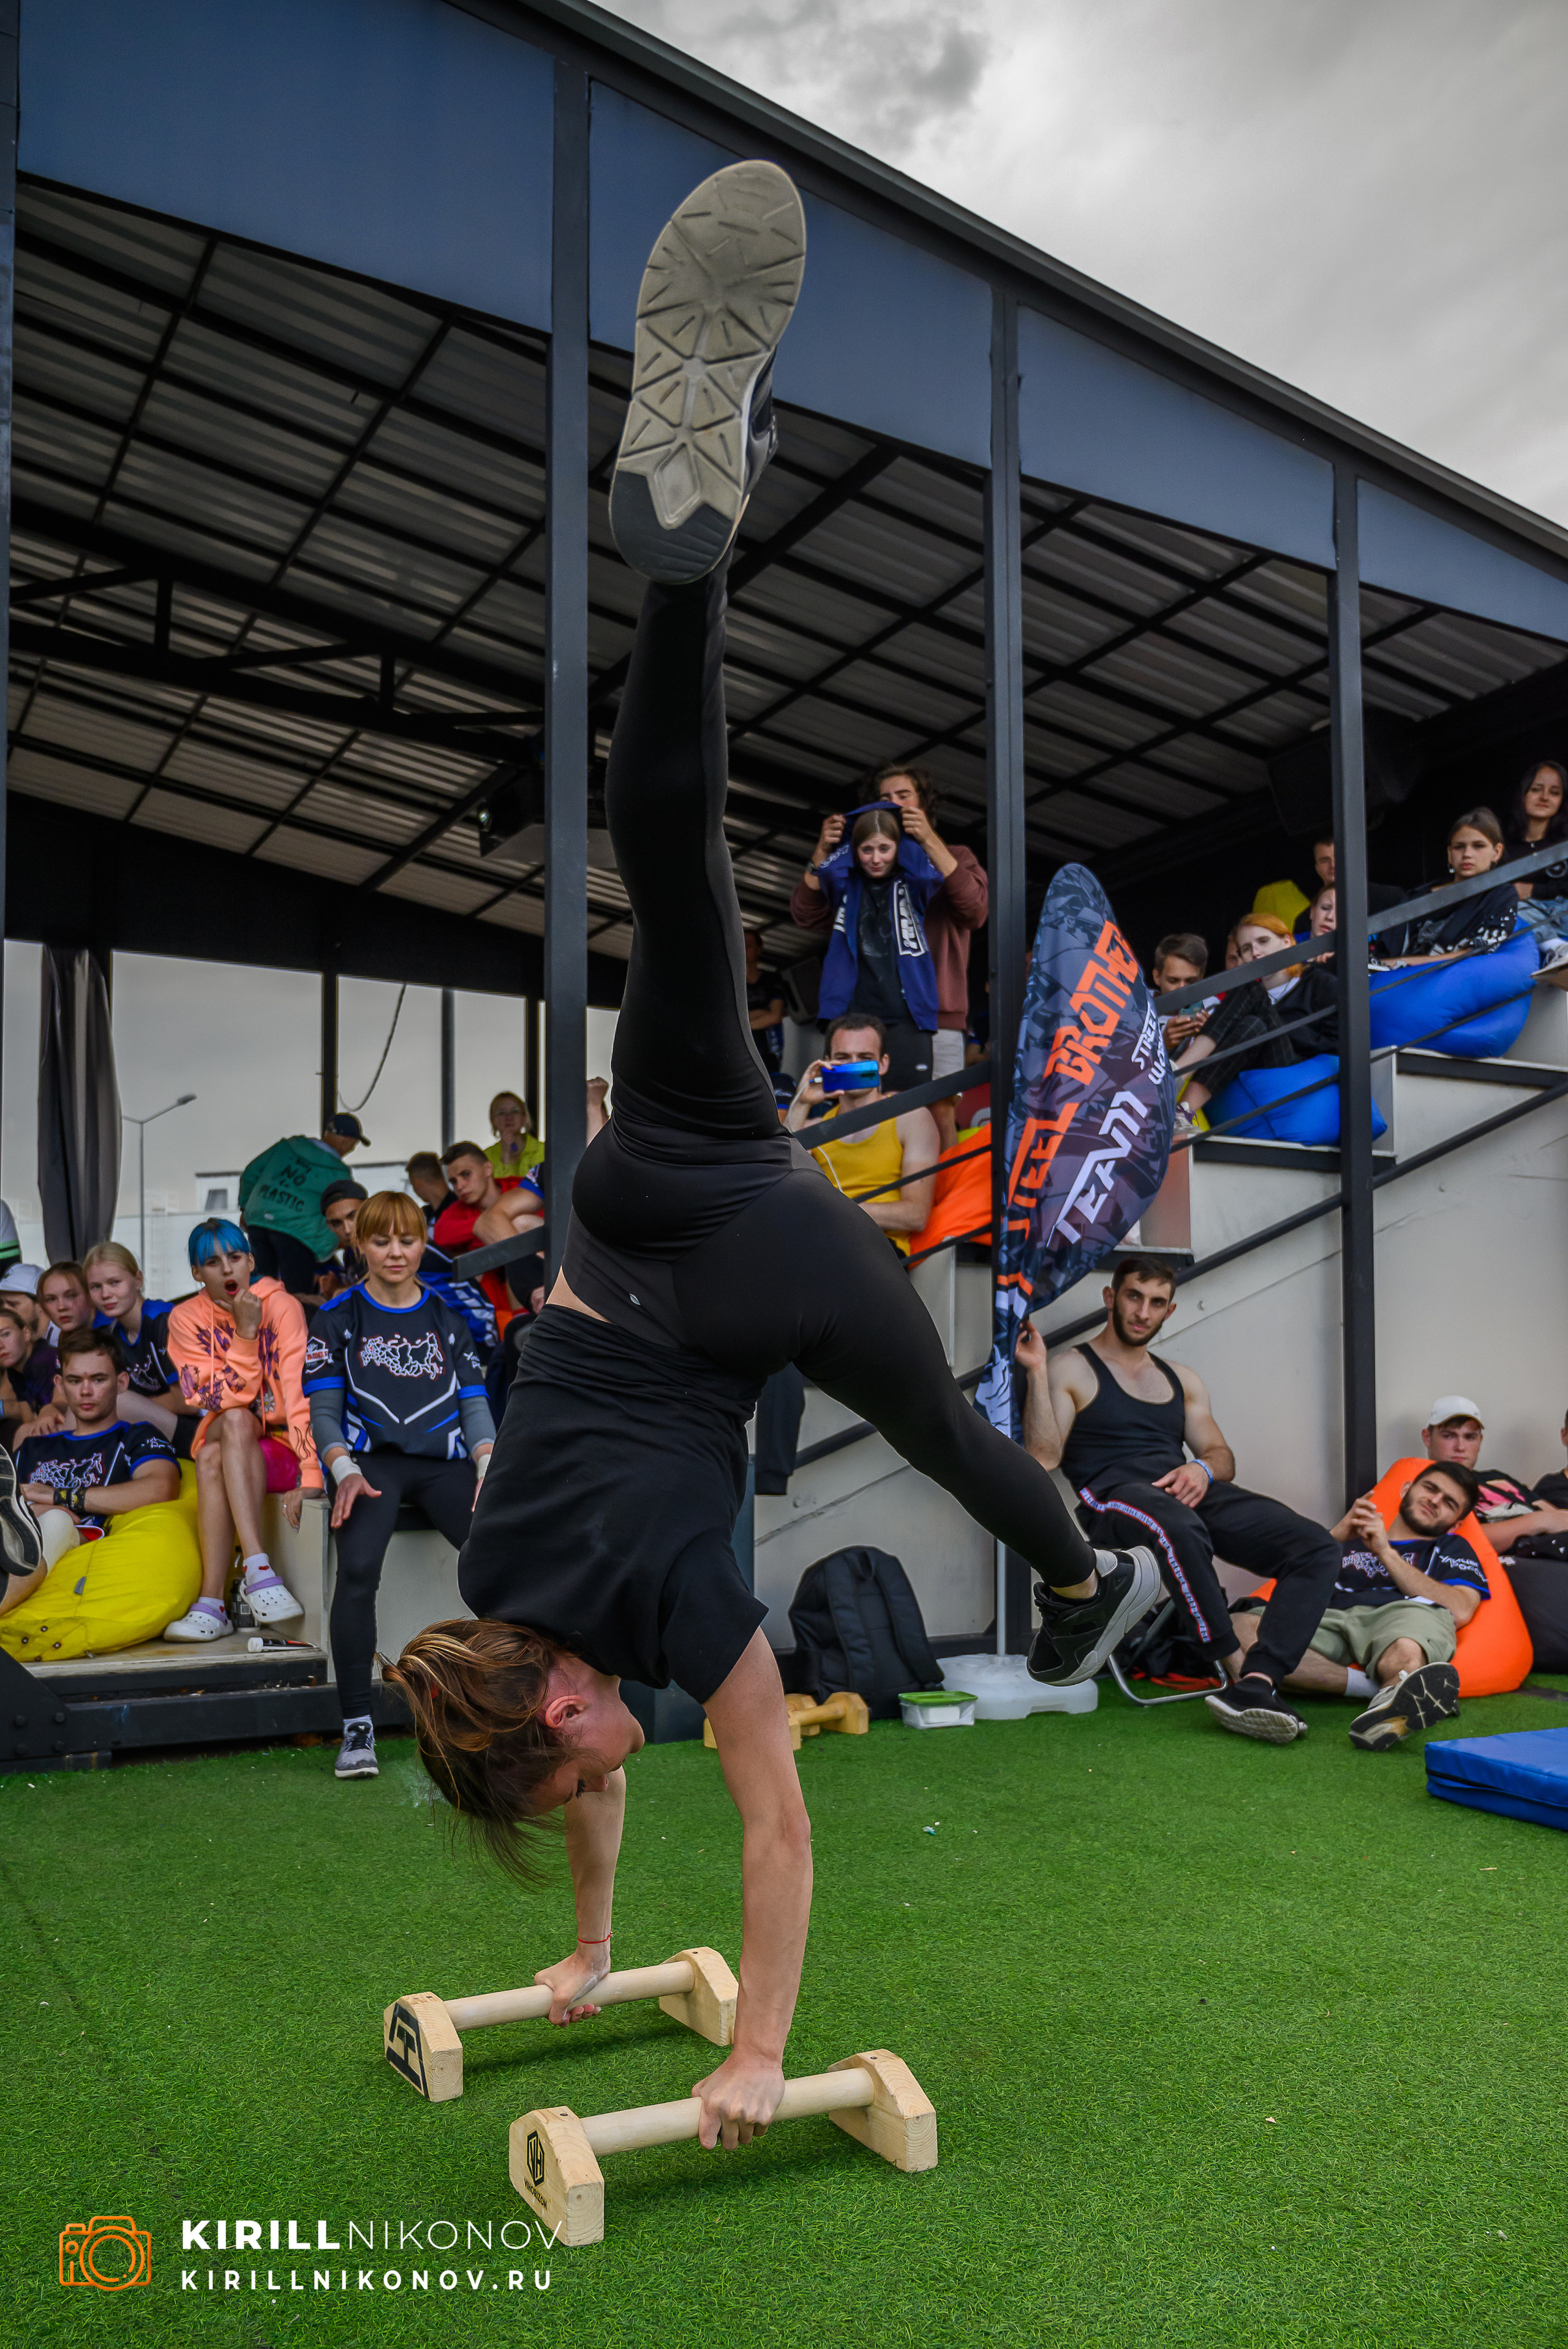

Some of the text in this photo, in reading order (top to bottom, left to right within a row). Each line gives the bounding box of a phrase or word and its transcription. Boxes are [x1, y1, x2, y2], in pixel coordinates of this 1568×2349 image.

[281, 1164, 306, 1187] NO
[1046, 1091, 1148, 1247] TEAM
[260, 1184, 305, 1212] PLASTIC
[524, 2177, 548, 2211] VIHORIZON
